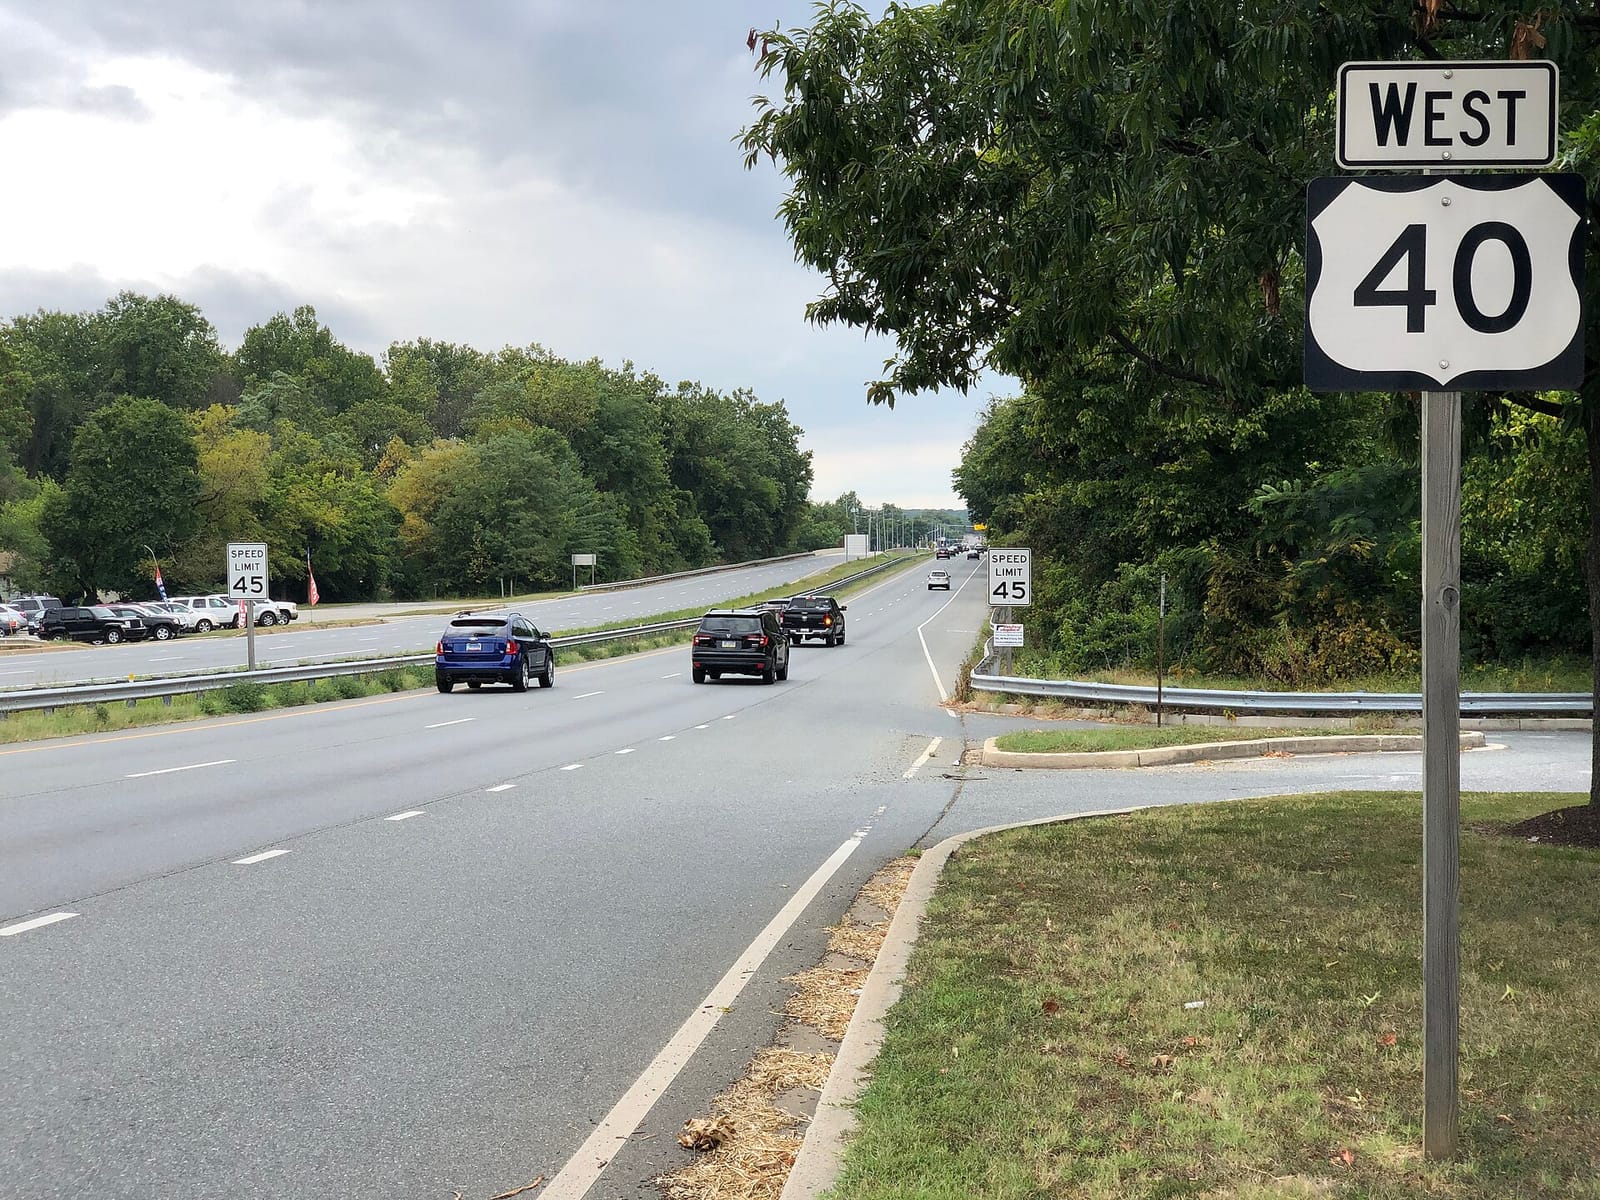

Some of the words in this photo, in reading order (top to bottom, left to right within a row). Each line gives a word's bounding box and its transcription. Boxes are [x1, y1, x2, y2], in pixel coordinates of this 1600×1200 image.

[1368, 82, 1526, 147] WEST
[1354, 221, 1532, 334] 40
[231, 550, 264, 559] SPEED
[992, 555, 1027, 563] SPEED
[234, 563, 260, 571] LIMIT
[996, 568, 1022, 576] LIMIT
[233, 576, 263, 593] 45
[992, 581, 1026, 599] 45
